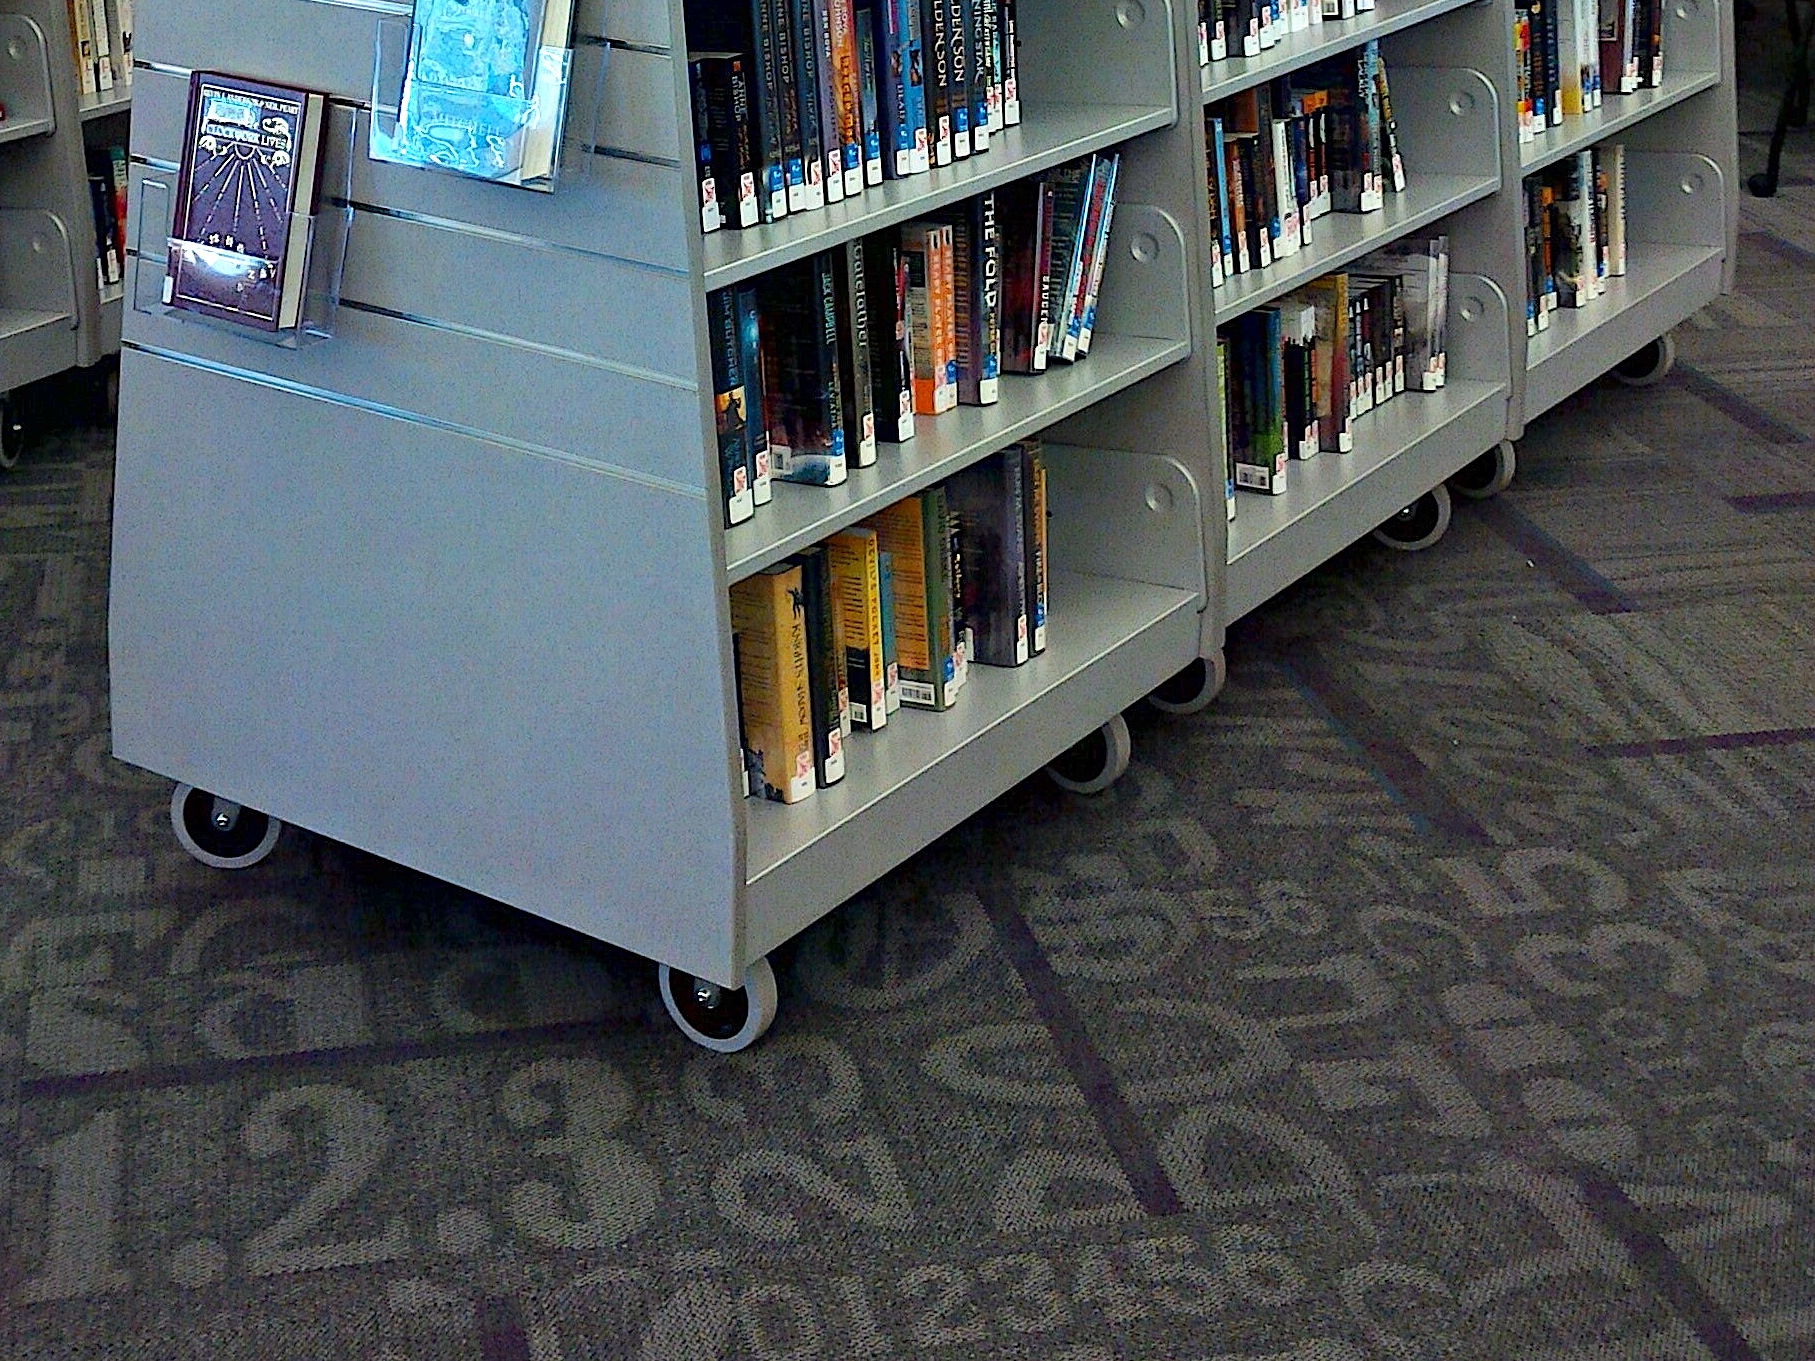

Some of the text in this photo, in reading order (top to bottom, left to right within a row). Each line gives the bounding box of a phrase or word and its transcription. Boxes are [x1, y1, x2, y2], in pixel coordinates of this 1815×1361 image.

[779, 33, 790, 84] BISHOP
[823, 32, 831, 58] BOVA
[953, 46, 965, 82] SON
[974, 42, 985, 83] STAR
[937, 50, 947, 87] SON
[984, 195, 996, 240] THE
[984, 247, 997, 308] FOLD
[822, 273, 836, 345] JACK CAMPBELL
[828, 382, 838, 429] LEVIATHA
